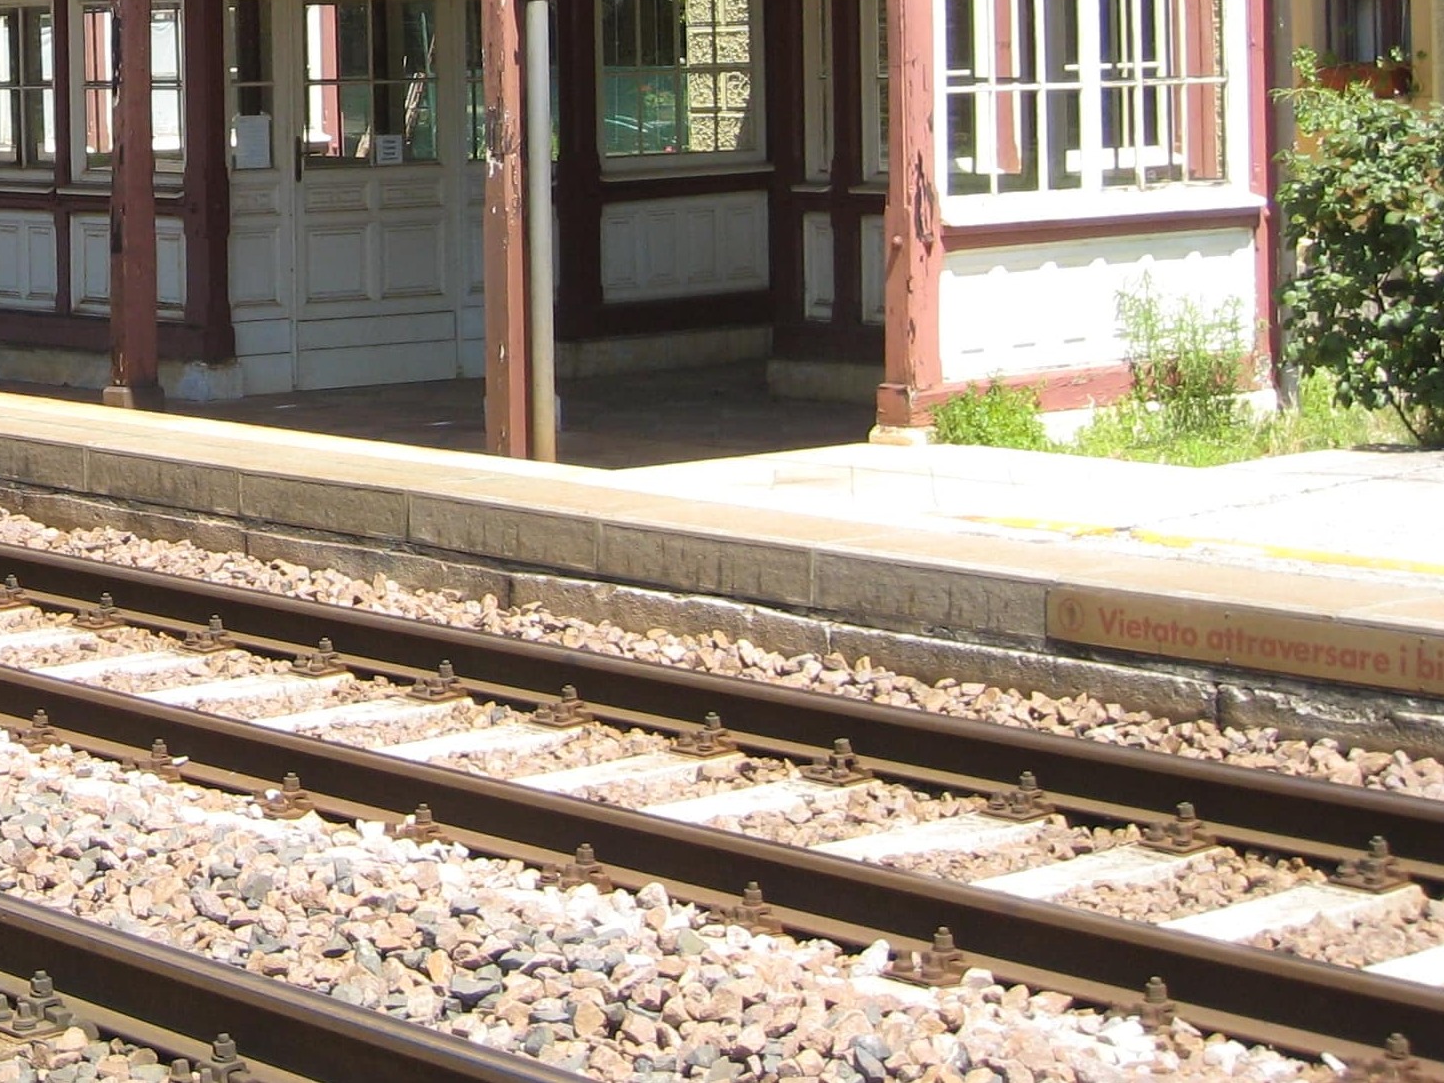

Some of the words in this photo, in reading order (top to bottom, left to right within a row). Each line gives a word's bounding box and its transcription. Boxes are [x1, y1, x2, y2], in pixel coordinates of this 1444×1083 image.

[1098, 606, 1198, 647] Vietato
[1206, 627, 1391, 675] attraversare
[1399, 641, 1407, 675] i
